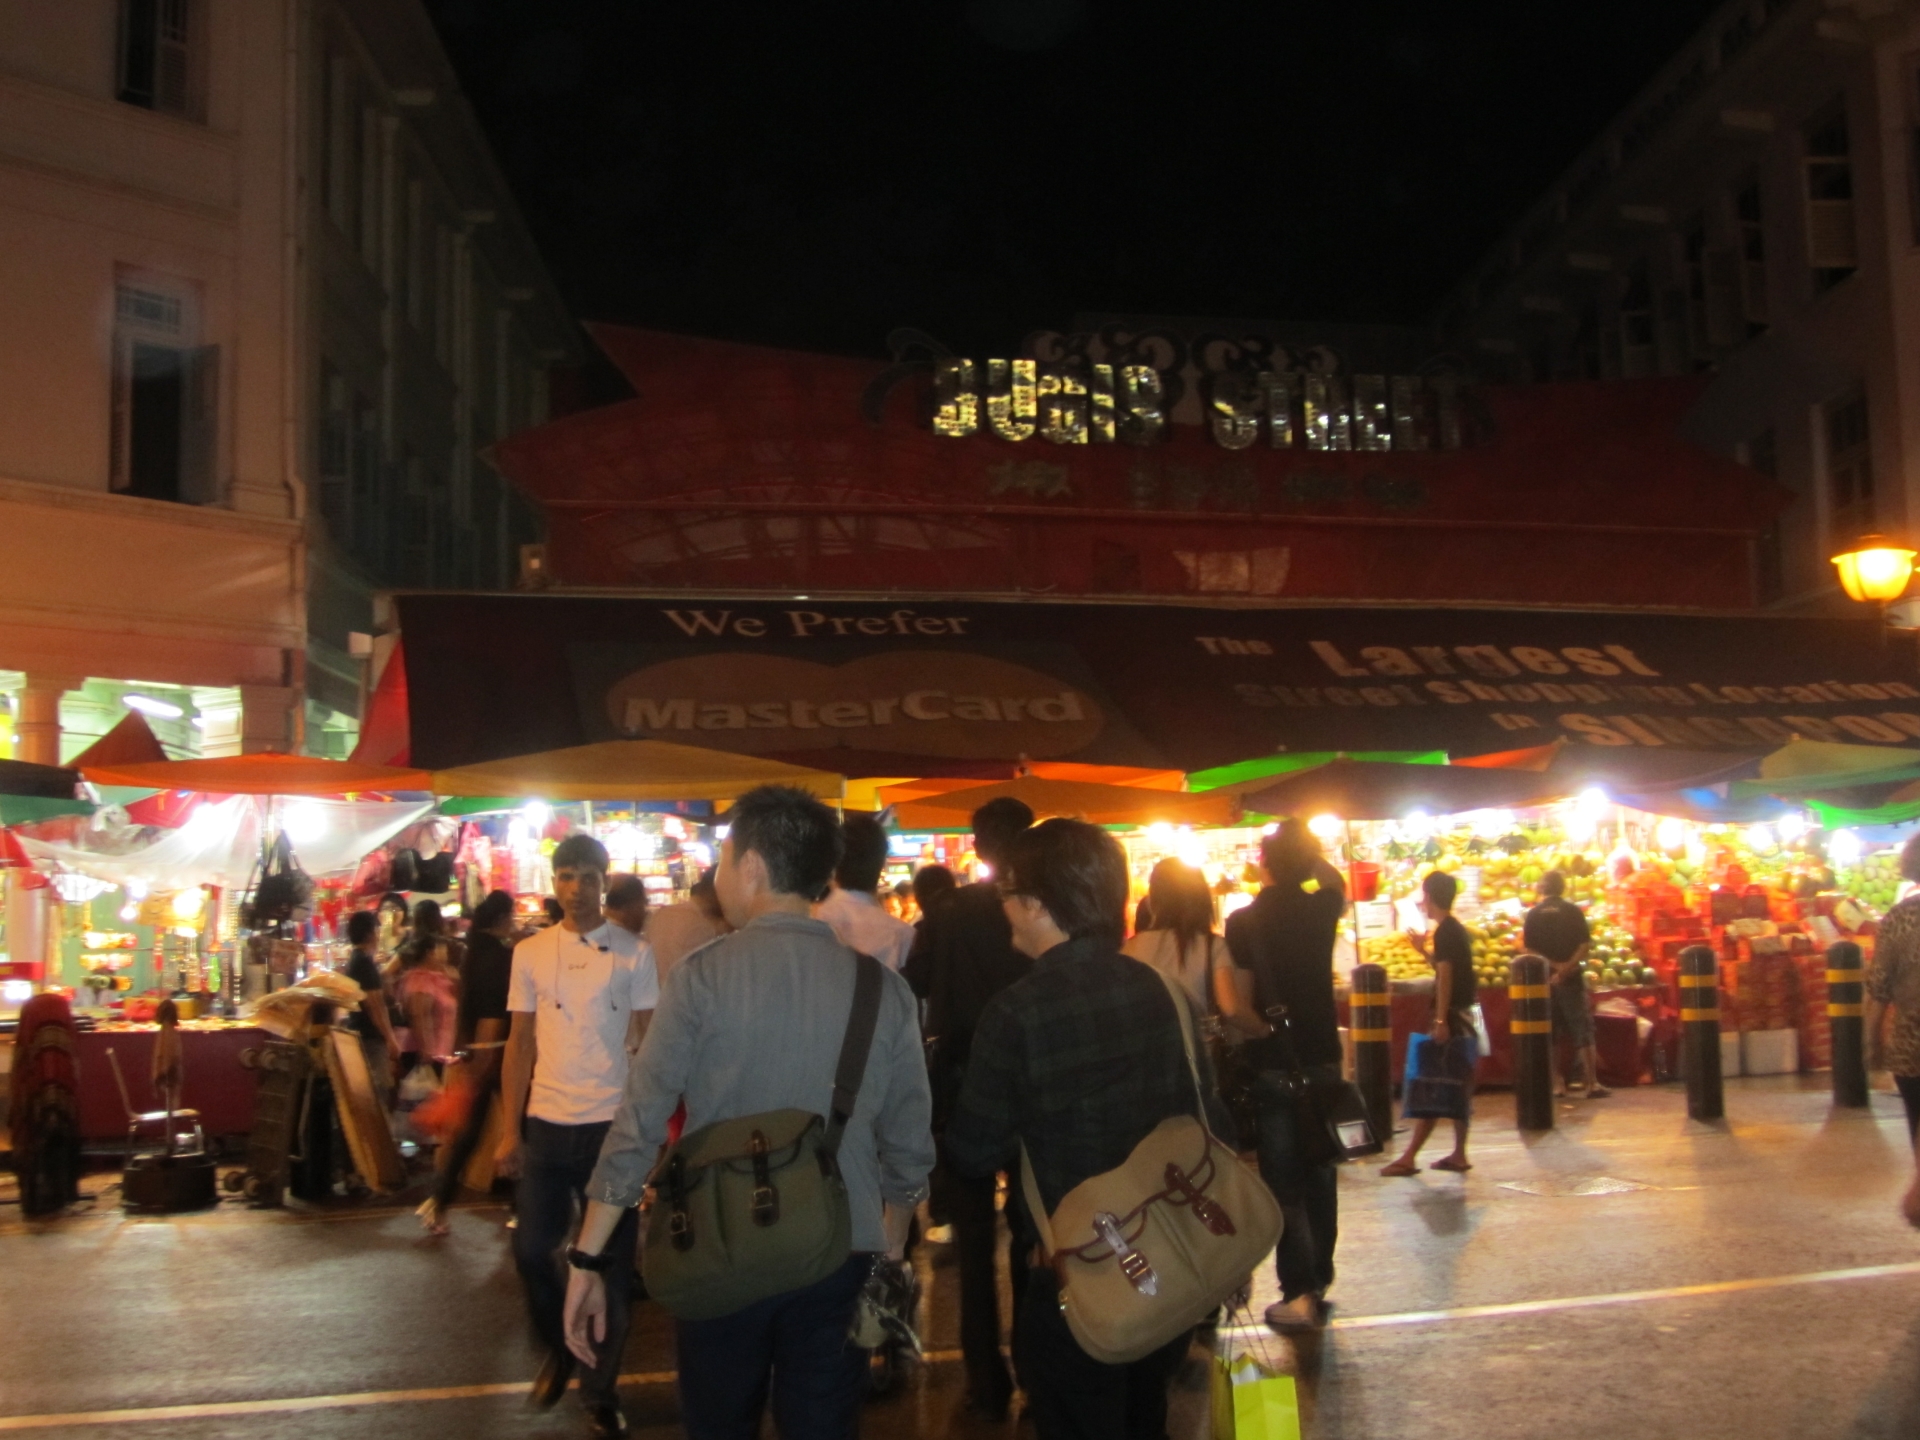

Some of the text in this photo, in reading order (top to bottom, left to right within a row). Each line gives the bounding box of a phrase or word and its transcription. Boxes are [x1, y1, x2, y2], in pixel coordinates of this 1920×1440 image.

[661, 609, 970, 638] We Prefer
[1195, 636, 1662, 678] The Largest
[621, 689, 1087, 734] MasterCard
[1234, 680, 1919, 709] Street Shopping Location
